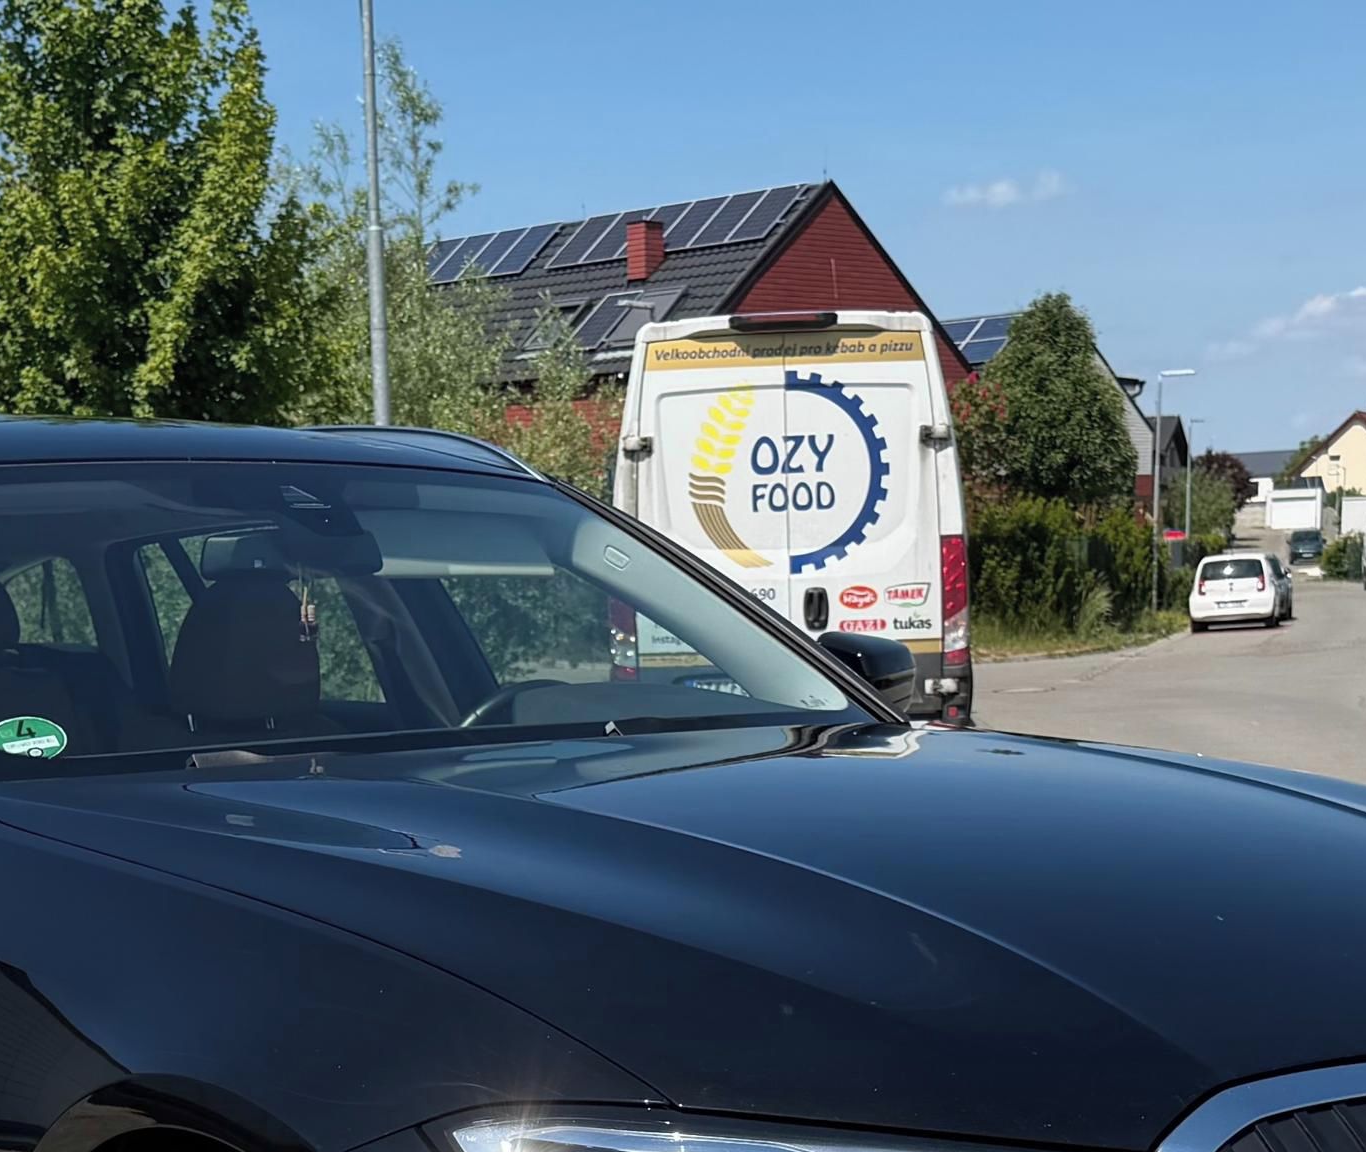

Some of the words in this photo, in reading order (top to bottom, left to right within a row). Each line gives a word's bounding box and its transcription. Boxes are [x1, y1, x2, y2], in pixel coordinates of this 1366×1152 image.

[751, 342, 798, 360] prodej
[799, 343, 823, 358] pro
[825, 339, 864, 354] kebab
[868, 342, 876, 353] a
[879, 338, 914, 356] pizzu
[750, 433, 835, 475] OZY
[751, 481, 836, 512] FOOD
[15, 719, 37, 739] 4
